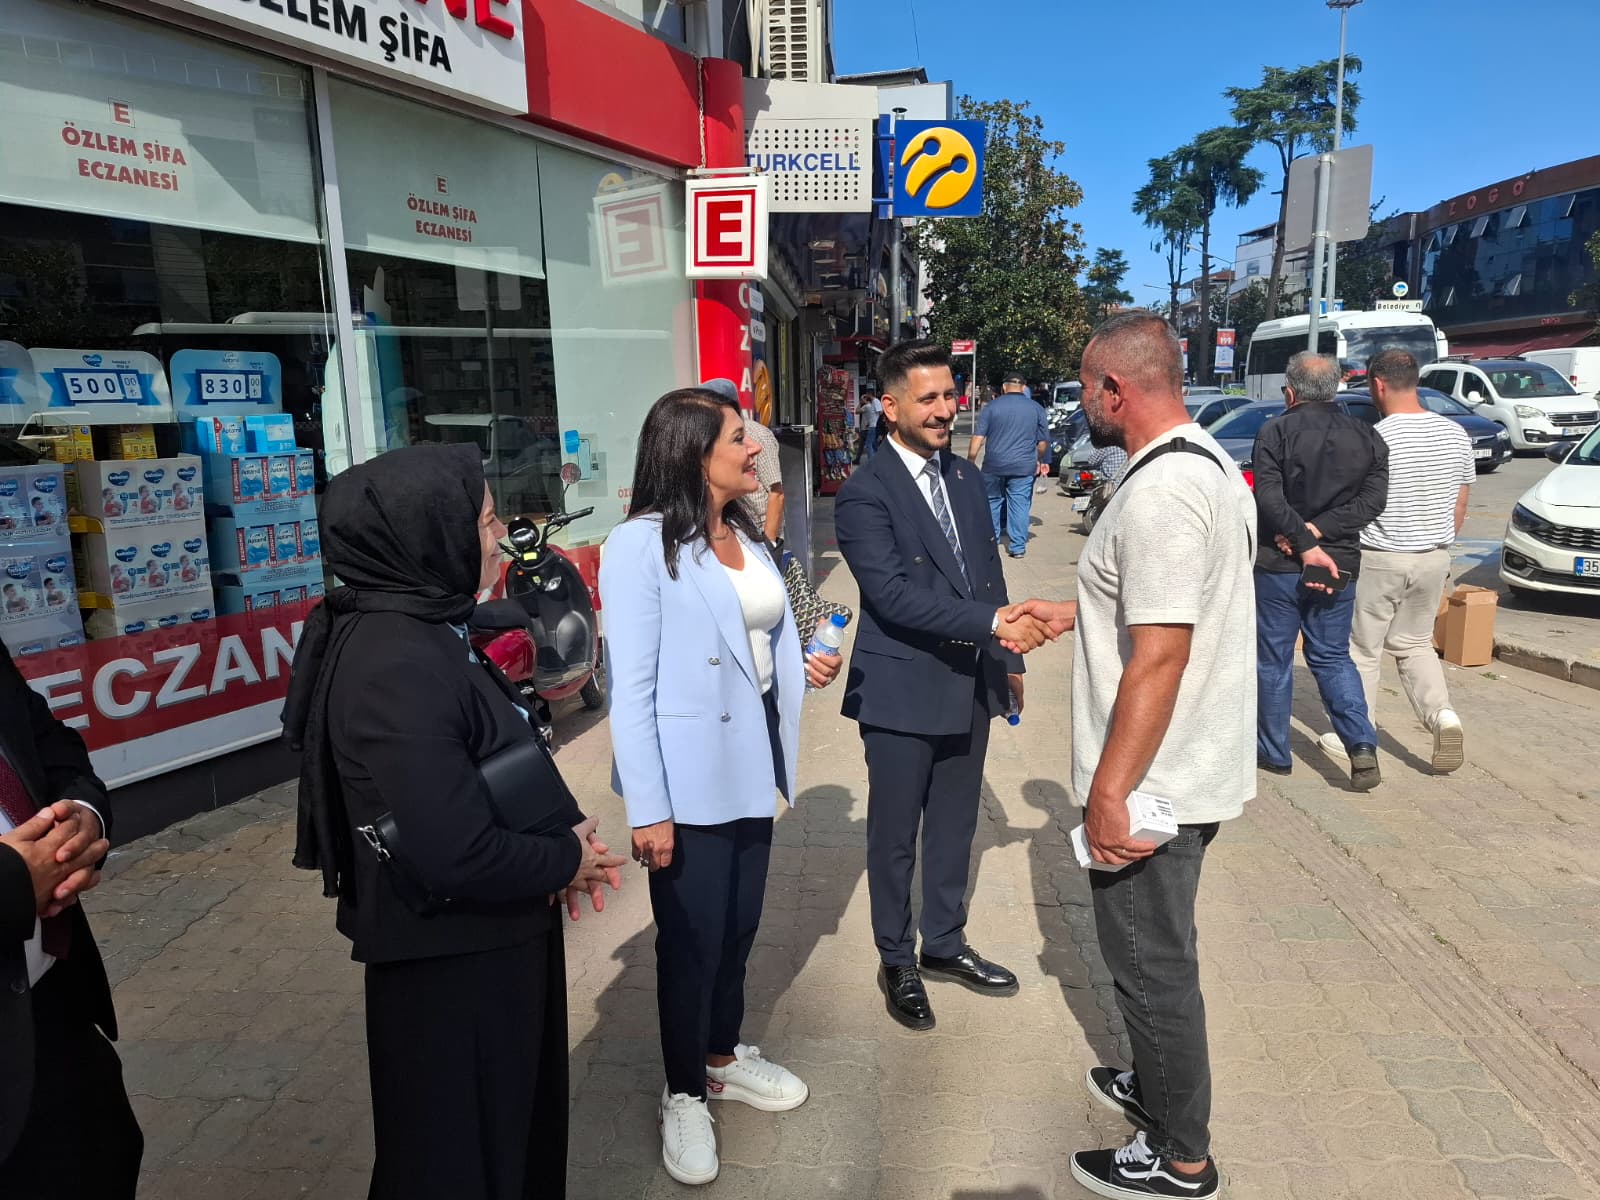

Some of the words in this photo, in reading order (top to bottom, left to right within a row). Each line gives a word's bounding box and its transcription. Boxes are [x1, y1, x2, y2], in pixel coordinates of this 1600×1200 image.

[379, 13, 452, 72] ŞİFA
[113, 102, 131, 124] E
[62, 121, 137, 156] ÖZLEM
[143, 140, 187, 166] ŞİFA
[745, 153, 861, 172] TURKCELL
[78, 158, 178, 191] ECZANESİ
[407, 192, 449, 217] ÖZLEM
[453, 204, 477, 223] ŞİFA
[416, 219, 472, 242] ECZANESİ
[706, 200, 742, 256] E
[1377, 302, 1410, 310] Belediye
[70, 377, 116, 394] 500
[206, 379, 242, 394] 830
[1584, 560, 1599, 573] 35
